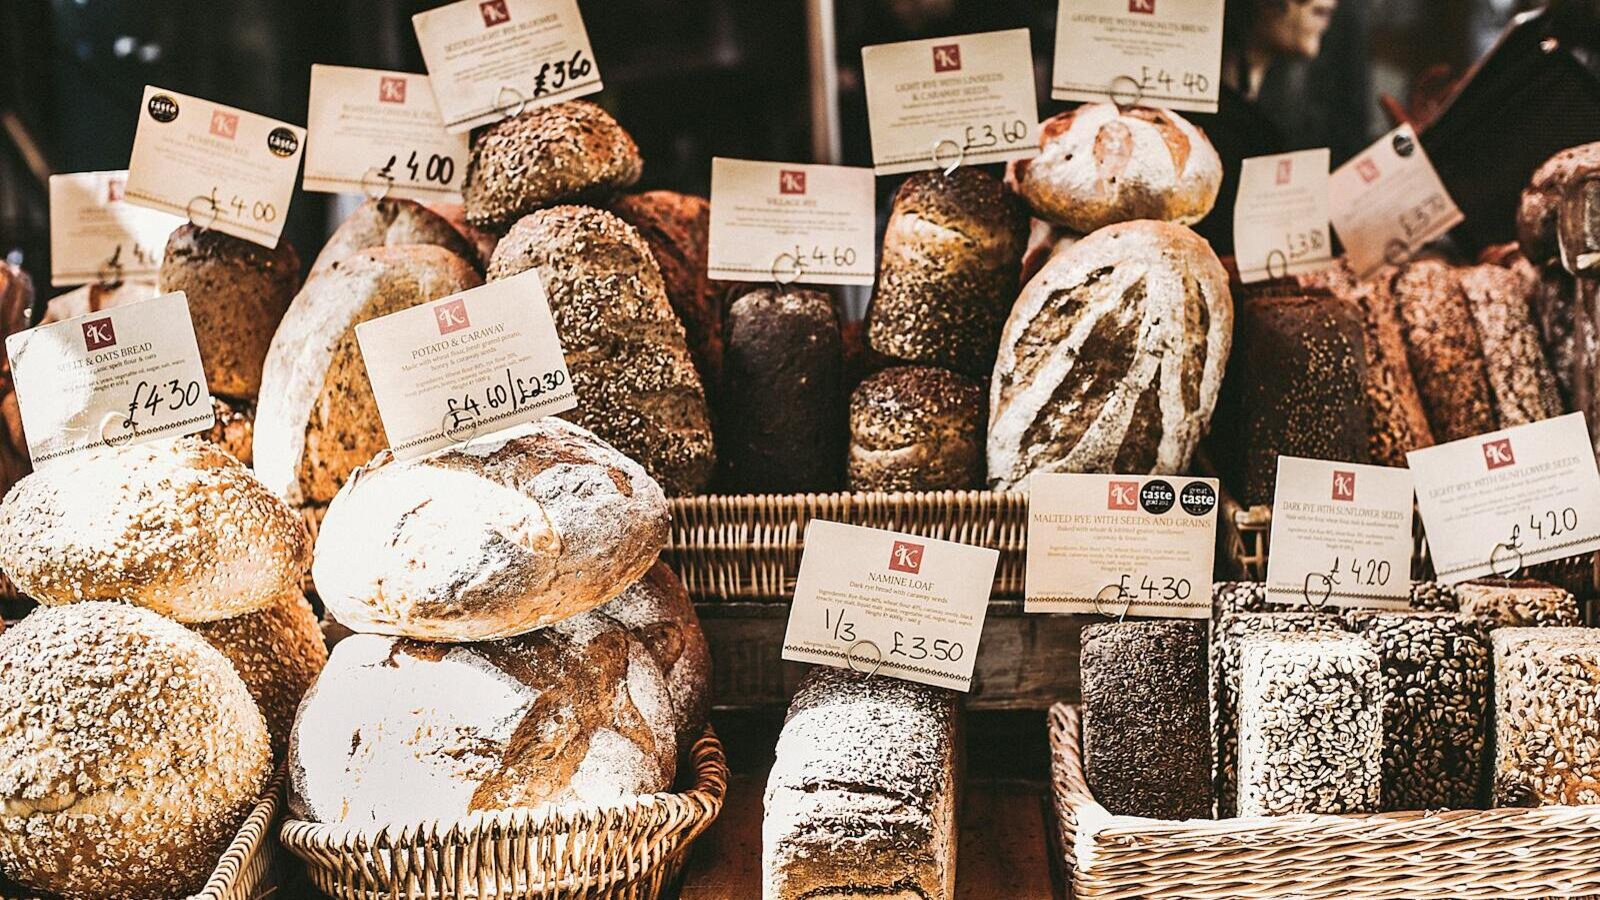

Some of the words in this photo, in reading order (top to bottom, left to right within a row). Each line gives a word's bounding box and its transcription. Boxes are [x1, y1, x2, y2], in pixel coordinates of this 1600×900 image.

[411, 340, 449, 359] POTATO
[451, 338, 459, 347] &
[460, 323, 505, 343] CARAWAY
[86, 357, 94, 366] &
[95, 351, 120, 364] OATS
[120, 342, 153, 358] BREAD
[1428, 485, 1455, 499] LIGHT
[1456, 481, 1472, 491] RYE
[1474, 476, 1498, 487] WITH
[1498, 462, 1551, 482] SUNFLOWER
[1552, 456, 1581, 469] SEEDS
[1142, 490, 1173, 500] taste
[1182, 494, 1215, 505] taste
[1034, 513, 1073, 523] MALTED
[1074, 514, 1092, 524] RYE
[1094, 515, 1119, 525] WITH
[1120, 516, 1151, 526] SEEDS
[1152, 517, 1174, 527] AND
[1175, 518, 1211, 528] GRAINS
[1283, 501, 1302, 511] DARK
[1302, 502, 1315, 512] RYE
[1317, 504, 1335, 514] WITH
[1336, 505, 1380, 518] SUNFLOWER
[1381, 510, 1404, 520] SEEDS
[869, 571, 908, 588] NAMINE
[908, 579, 935, 592] LOAF
[1117, 574, 1191, 599] £4.30
[906, 592, 930, 601] caraway
[826, 608, 856, 642] 1/3
[890, 631, 964, 662] £3.50
